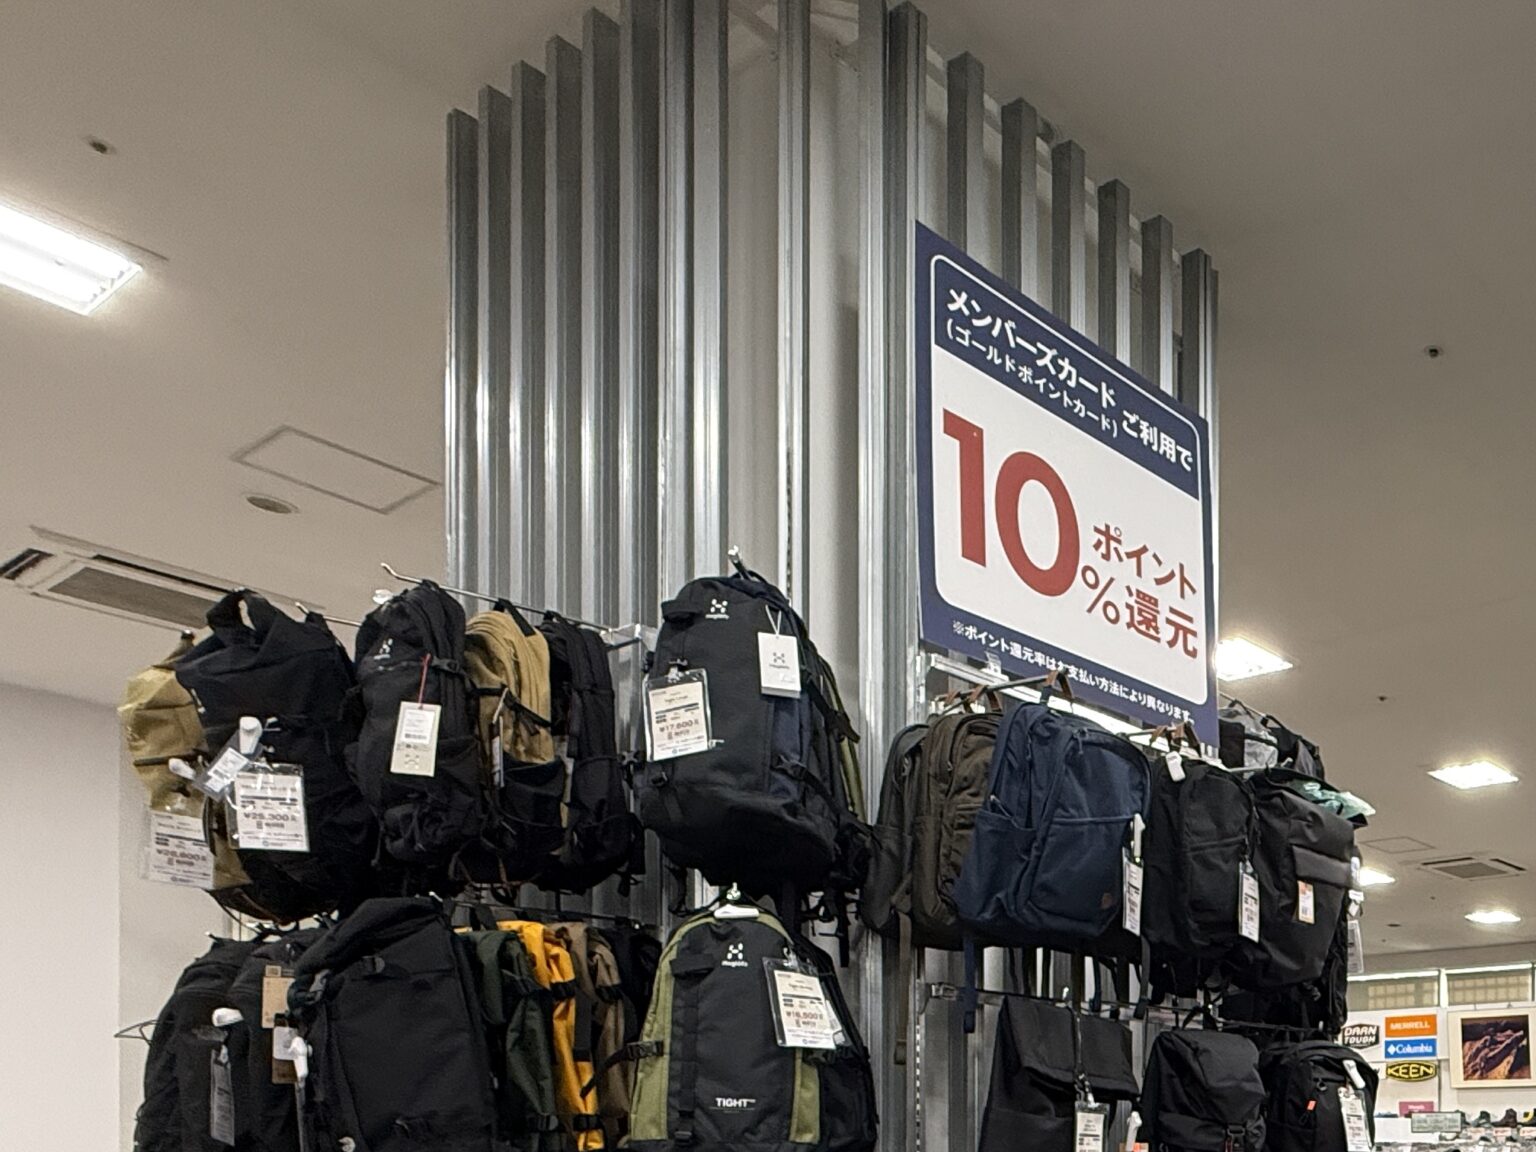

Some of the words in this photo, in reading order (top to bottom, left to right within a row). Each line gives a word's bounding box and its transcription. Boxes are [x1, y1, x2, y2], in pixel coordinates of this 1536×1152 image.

[947, 319, 1118, 438] (ゴールドポイントカード)
[947, 289, 1116, 409] メンバーズカード
[1122, 410, 1193, 471] ご利用で
[943, 407, 1081, 598] 10
[1093, 523, 1197, 598] ポイント
[1344, 1026, 1377, 1036] DARN
[1390, 1021, 1430, 1030] MERRELL
[1344, 1036, 1376, 1045] TOUGH
[1396, 1043, 1433, 1054] Columbia
[1387, 1063, 1433, 1079] KEEN
